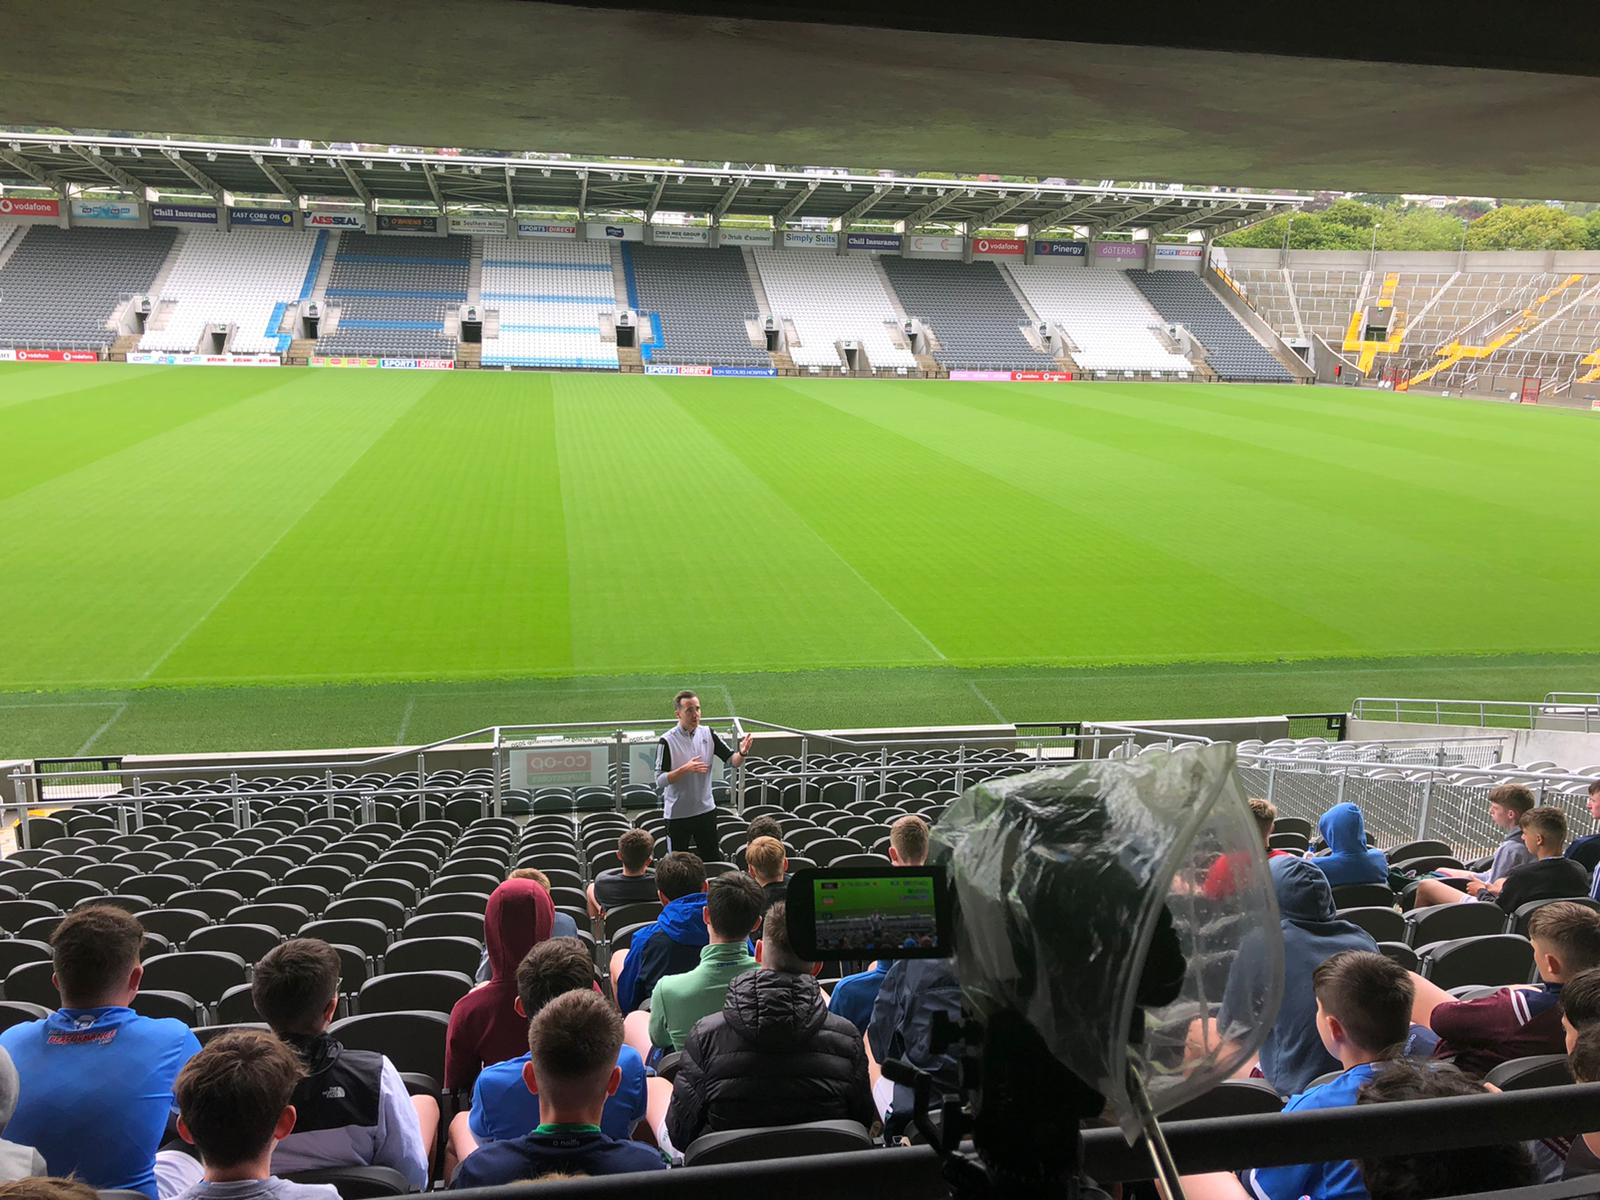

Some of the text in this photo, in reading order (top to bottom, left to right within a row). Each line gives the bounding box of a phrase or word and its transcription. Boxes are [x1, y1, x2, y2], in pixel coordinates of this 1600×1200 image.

[14, 203, 52, 212] vodafone
[153, 209, 217, 219] Chill Insurance
[785, 233, 836, 243] Simply Suits
[1053, 244, 1082, 255] Pinergy
[647, 366, 709, 375] SPORTS DIRECT
